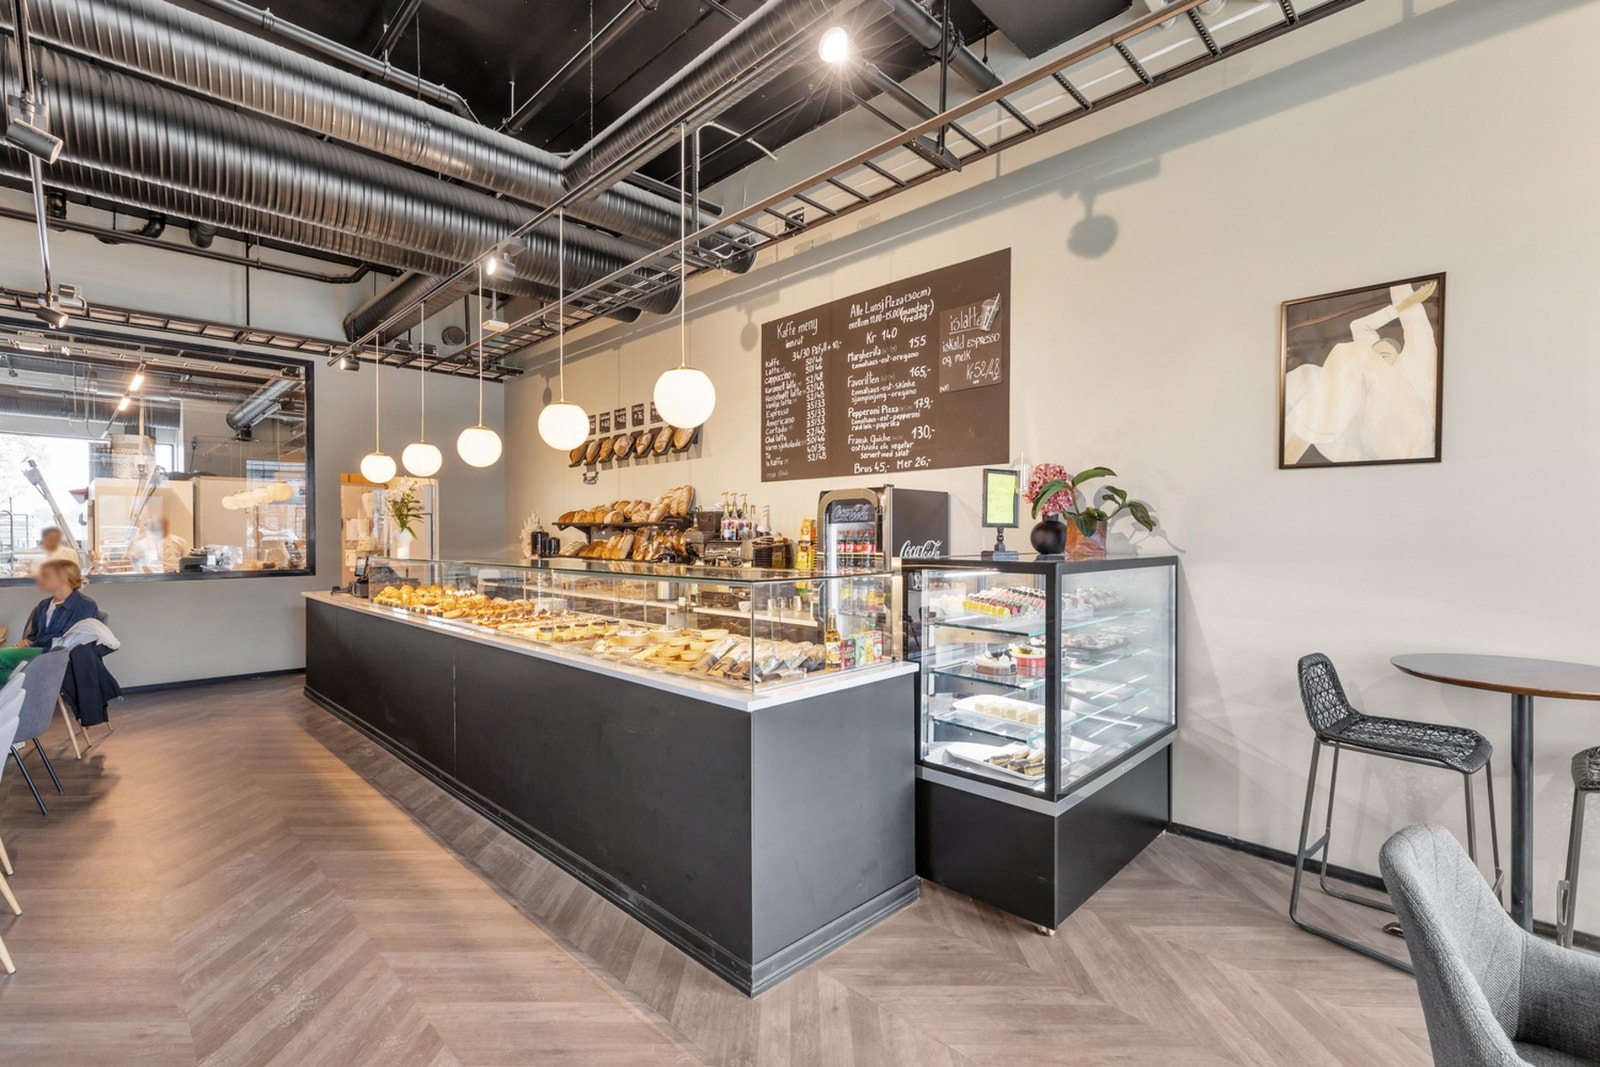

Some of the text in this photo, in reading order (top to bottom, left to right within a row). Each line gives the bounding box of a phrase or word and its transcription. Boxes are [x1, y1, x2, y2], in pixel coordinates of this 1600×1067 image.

[850, 304, 864, 318] Alle
[777, 318, 818, 339] Kaffe meny
[848, 317, 870, 330] mellom
[866, 327, 898, 344] Kr 140
[847, 345, 881, 362] Margherita
[909, 335, 927, 348] 155
[942, 356, 952, 368] og
[847, 405, 880, 418] Pepperoni
[881, 404, 899, 414] Pizza
[854, 463, 873, 474] Brus
[896, 460, 913, 469] Mer
